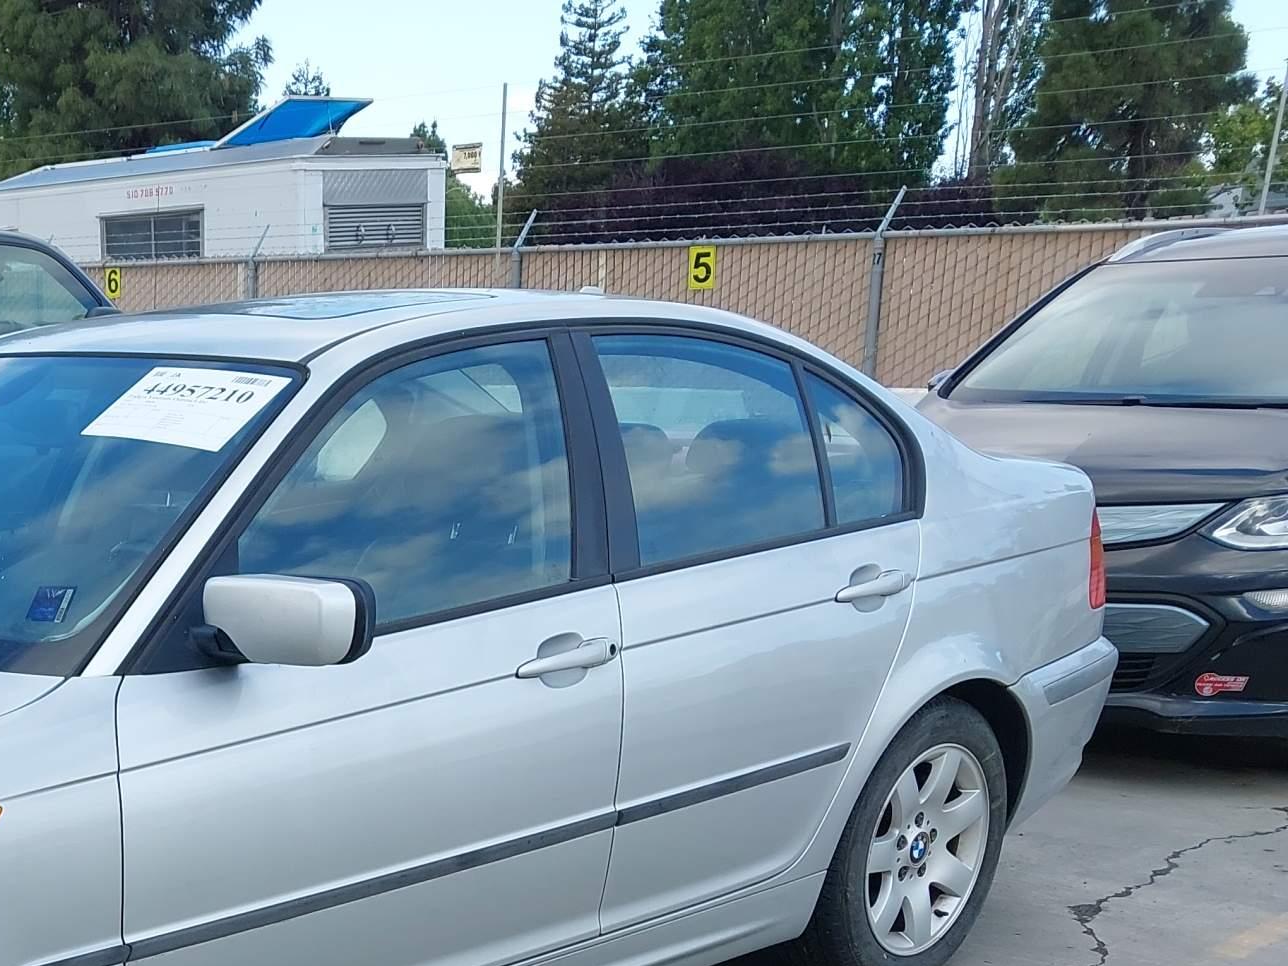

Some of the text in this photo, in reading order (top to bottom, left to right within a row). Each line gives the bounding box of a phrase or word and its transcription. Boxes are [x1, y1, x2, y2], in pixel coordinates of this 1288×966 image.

[692, 251, 712, 284] 5
[107, 269, 119, 294] 6
[143, 381, 256, 405] 44957210
